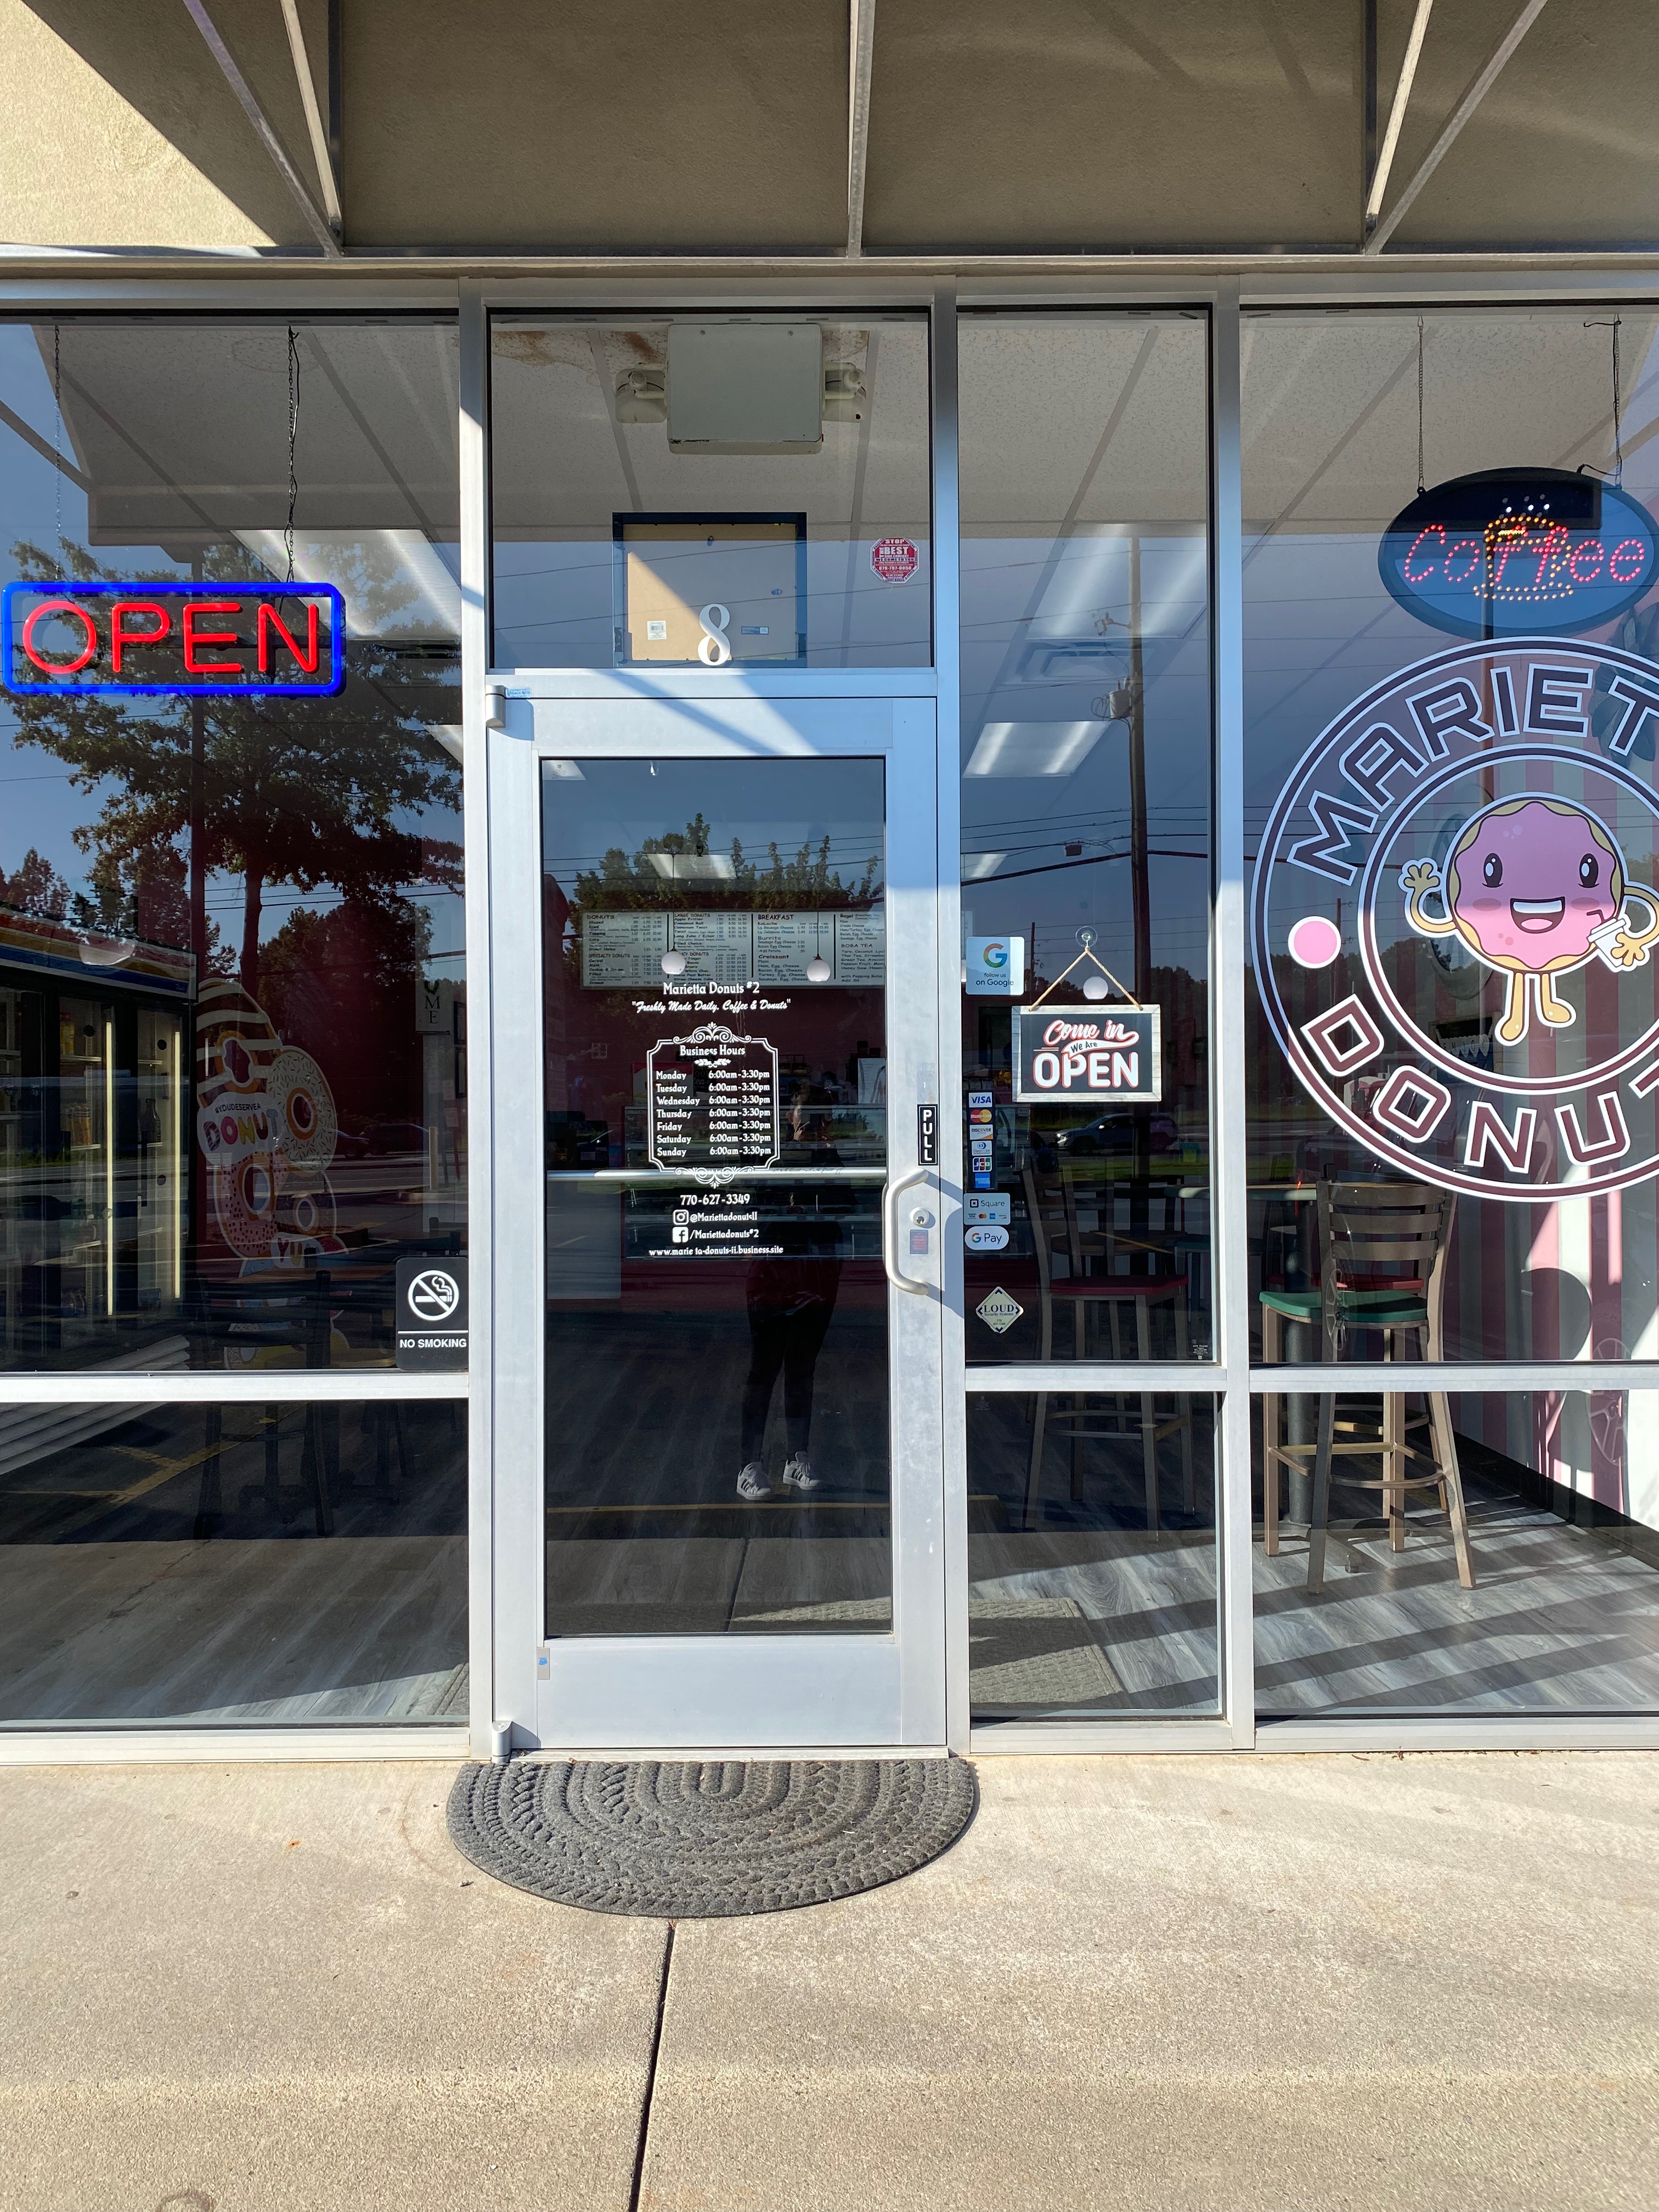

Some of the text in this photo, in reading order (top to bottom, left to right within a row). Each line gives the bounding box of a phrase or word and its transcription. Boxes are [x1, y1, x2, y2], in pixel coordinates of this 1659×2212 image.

[1404, 525, 1645, 582] Coffee
[22, 600, 320, 674] OPEN
[698, 603, 731, 666] 8
[663, 981, 760, 995] Marietta Donuts #2
[987, 979, 1014, 987] Google
[668, 1001, 692, 1011] Made
[723, 1000, 748, 1013] Coffee
[750, 1000, 757, 1010] &
[1043, 1019, 1139, 1046] Come in
[680, 1045, 746, 1056] Business Hours
[1071, 1043, 1083, 1053] We
[656, 1070, 770, 1080] Monday 6:00am-3:30pm
[1033, 1052, 1139, 1088] OPEN
[656, 1082, 770, 1093] Tuesday 6:00am-3:30pm
[1301, 994, 1659, 1173] DONU
[657, 1095, 770, 1106] Wednesday 6:00am-3:30pm
[215, 1102, 261, 1114] #YOUDESERVEA
[656, 1108, 771, 1119] Thursday 6:00am-3:30pm
[204, 1109, 278, 1151] DONUT
[657, 1121, 771, 1132] Friday 6:00am-3:30pm
[657, 1133, 771, 1144] Saturday 6:00am-3:30pm
[922, 1109, 933, 1161] PULL
[657, 1146, 771, 1157] Sunday 6:00am-3:30pm
[680, 1193, 751, 1205] 770-627-3349
[980, 1200, 1005, 1208] Square
[984, 1233, 1002, 1245] Pay
[984, 1305, 1014, 1313] LOUD
[399, 1339, 467, 1348] NO SMOKING
